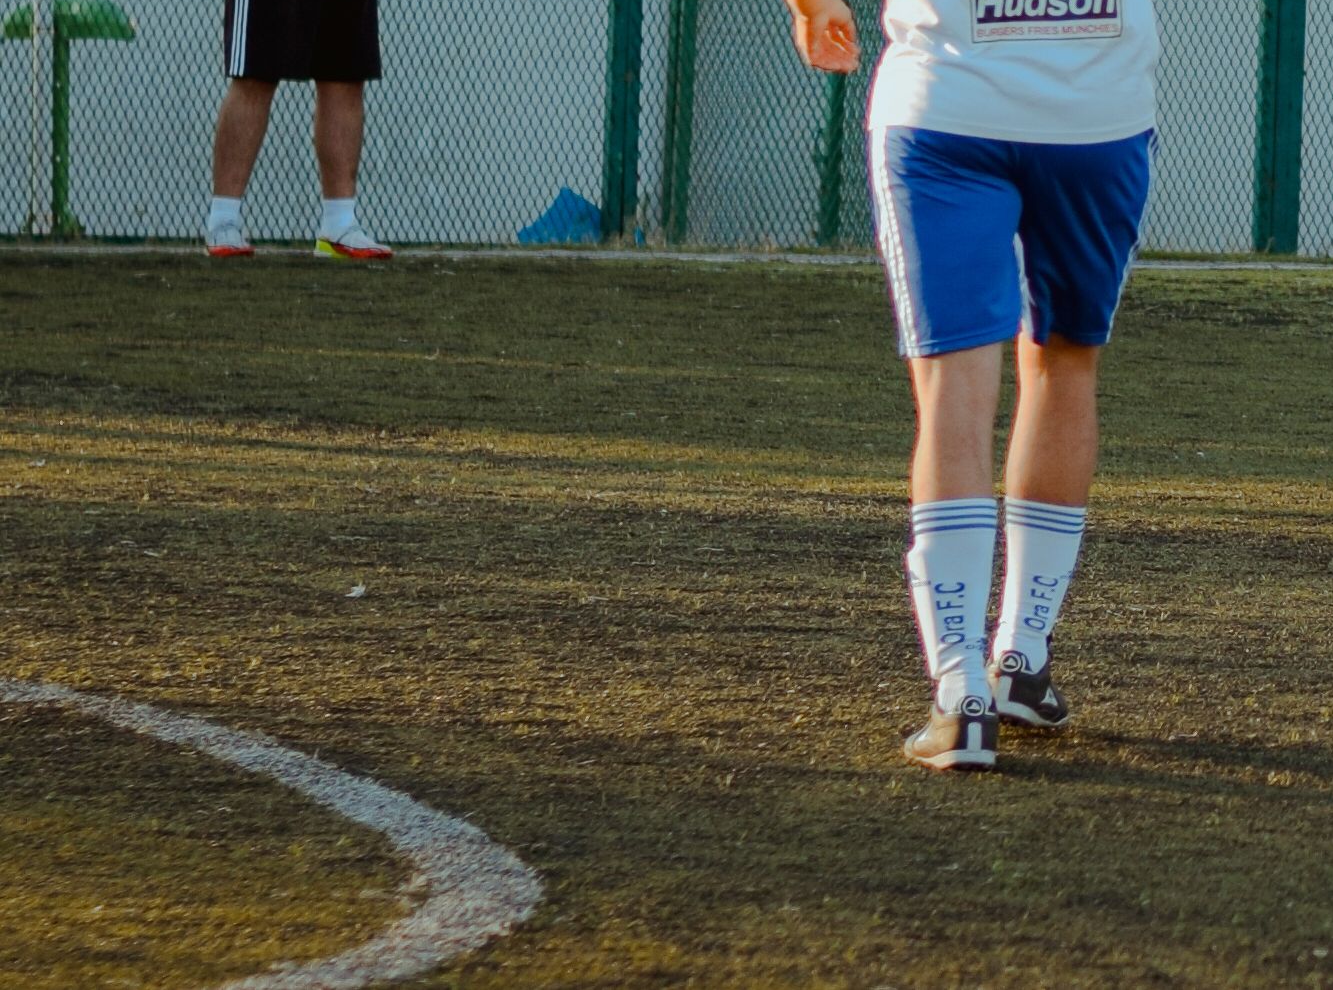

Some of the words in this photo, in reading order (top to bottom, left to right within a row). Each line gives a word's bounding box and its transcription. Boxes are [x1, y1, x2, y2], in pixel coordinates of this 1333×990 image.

[976, 26, 1025, 38] BURGERS
[1027, 25, 1059, 36] FRIES
[1062, 23, 1119, 35] MUNCHIES
[934, 581, 966, 611] F.C
[1030, 575, 1059, 601] F.C
[940, 614, 966, 645] Ora
[1023, 604, 1050, 631] Ora
